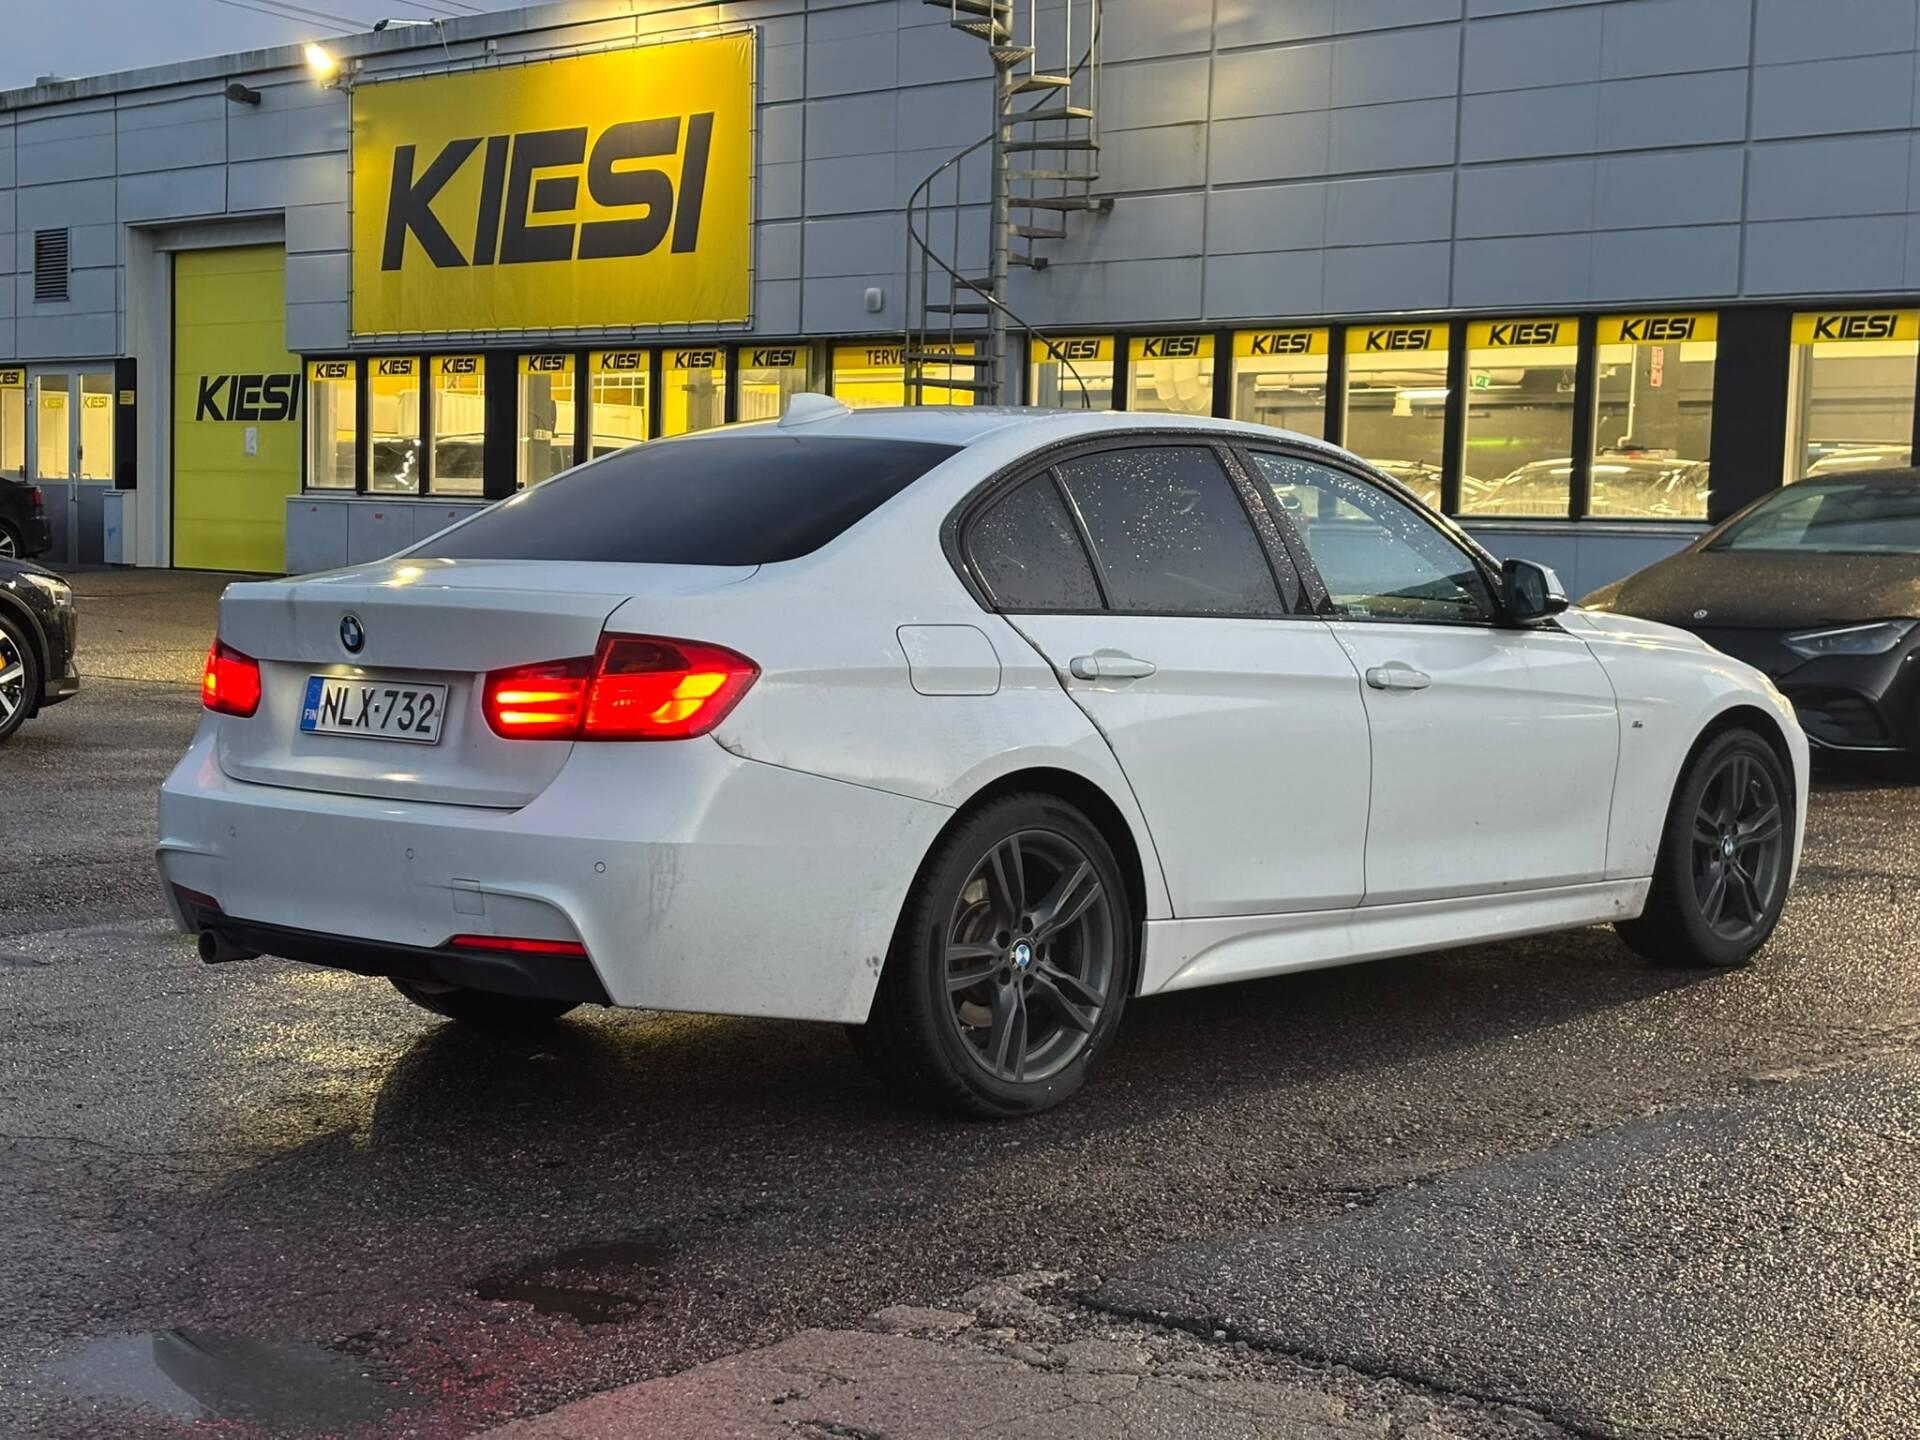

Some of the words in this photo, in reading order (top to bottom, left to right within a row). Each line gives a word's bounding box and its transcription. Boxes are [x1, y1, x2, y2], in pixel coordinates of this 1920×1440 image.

[381, 112, 715, 271] KIESI
[1488, 323, 1559, 346] KIESI
[1619, 318, 1696, 342] KIESI
[1813, 315, 1897, 341] KIESI
[1143, 337, 1199, 357] KIESI
[1251, 333, 1312, 355] KIESI
[1365, 329, 1432, 351] KIESI
[674, 351, 716, 368] KIESI
[751, 349, 796, 367] KIESI
[1046, 340, 1100, 360] KIESI
[378, 360, 413, 375] KIESI
[441, 358, 477, 374] KIESI
[527, 355, 565, 371] KIESI
[601, 352, 640, 369] KIESI
[315, 363, 348, 378] KIESI
[83, 396, 108, 409] KIESI
[196, 374, 301, 421] KIESI
[304, 708, 317, 721] FIN
